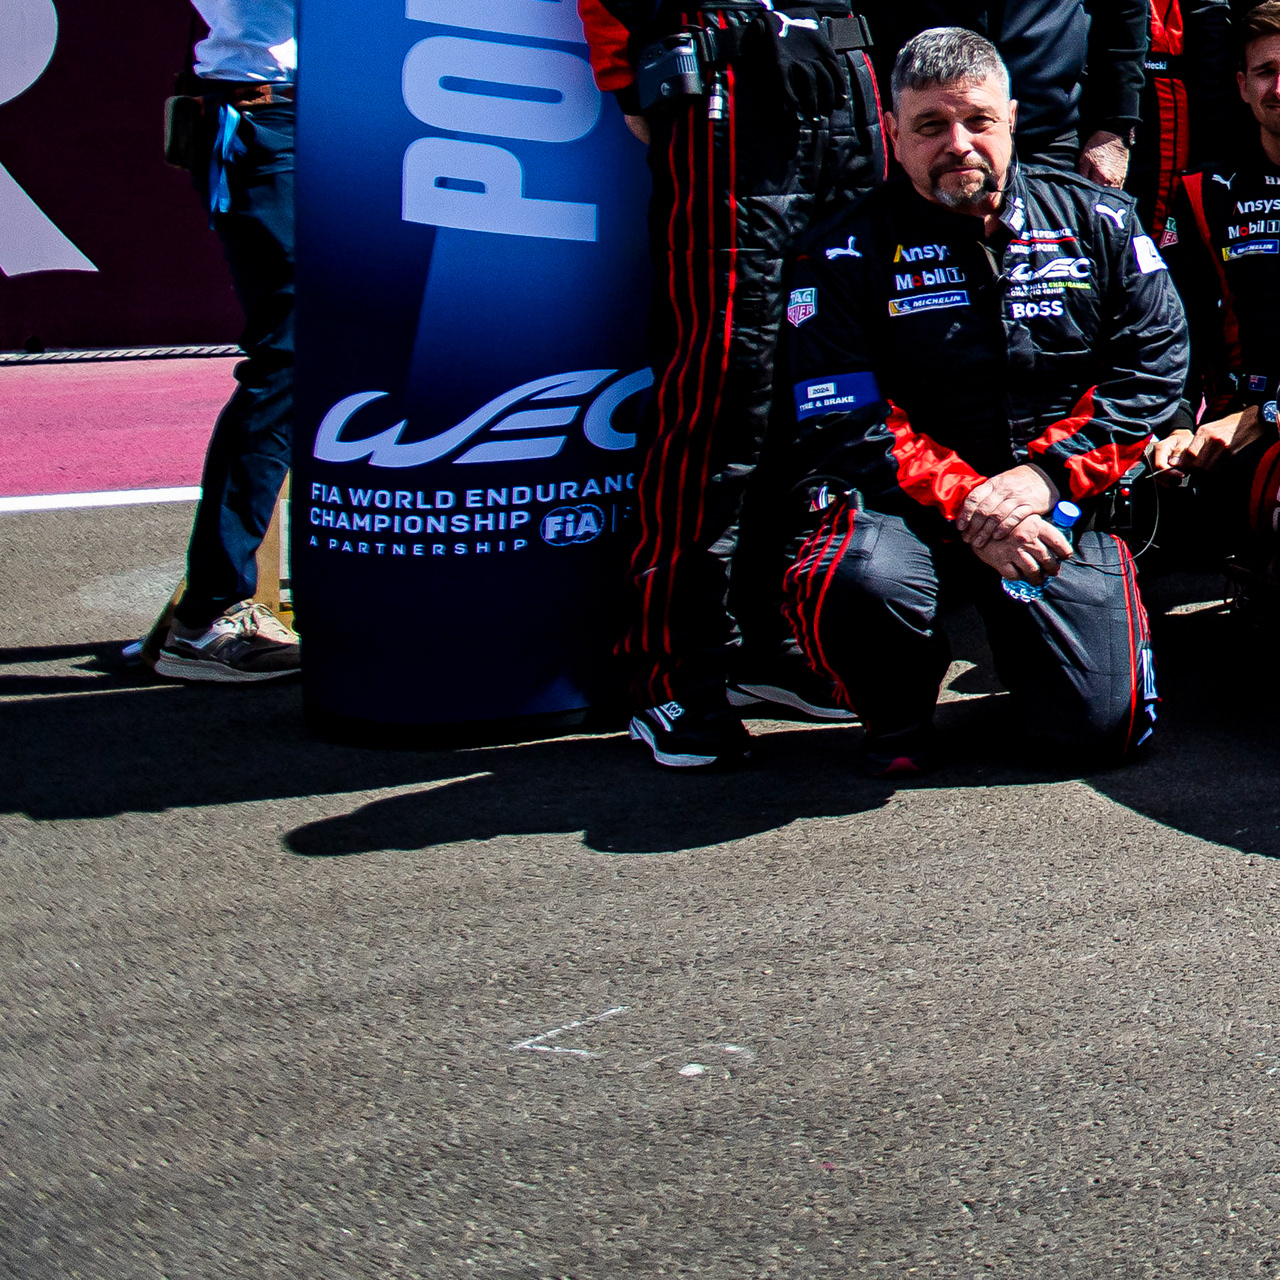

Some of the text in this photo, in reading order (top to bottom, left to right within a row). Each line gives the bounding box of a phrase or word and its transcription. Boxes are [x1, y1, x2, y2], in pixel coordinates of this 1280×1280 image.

[1228, 220, 1265, 239] Mobil
[893, 243, 952, 263] Ansy
[895, 268, 946, 291] Mobil
[912, 294, 962, 308] MICHELIN
[1012, 299, 1065, 319] BOSS
[823, 395, 855, 406] BRAKE
[313, 366, 656, 469] WEC
[310, 481, 343, 506] FIA
[348, 486, 457, 510] WORLD
[309, 506, 533, 535] CHAMPIONSHIP
[309, 535, 529, 557] A PARTNERSHIP
